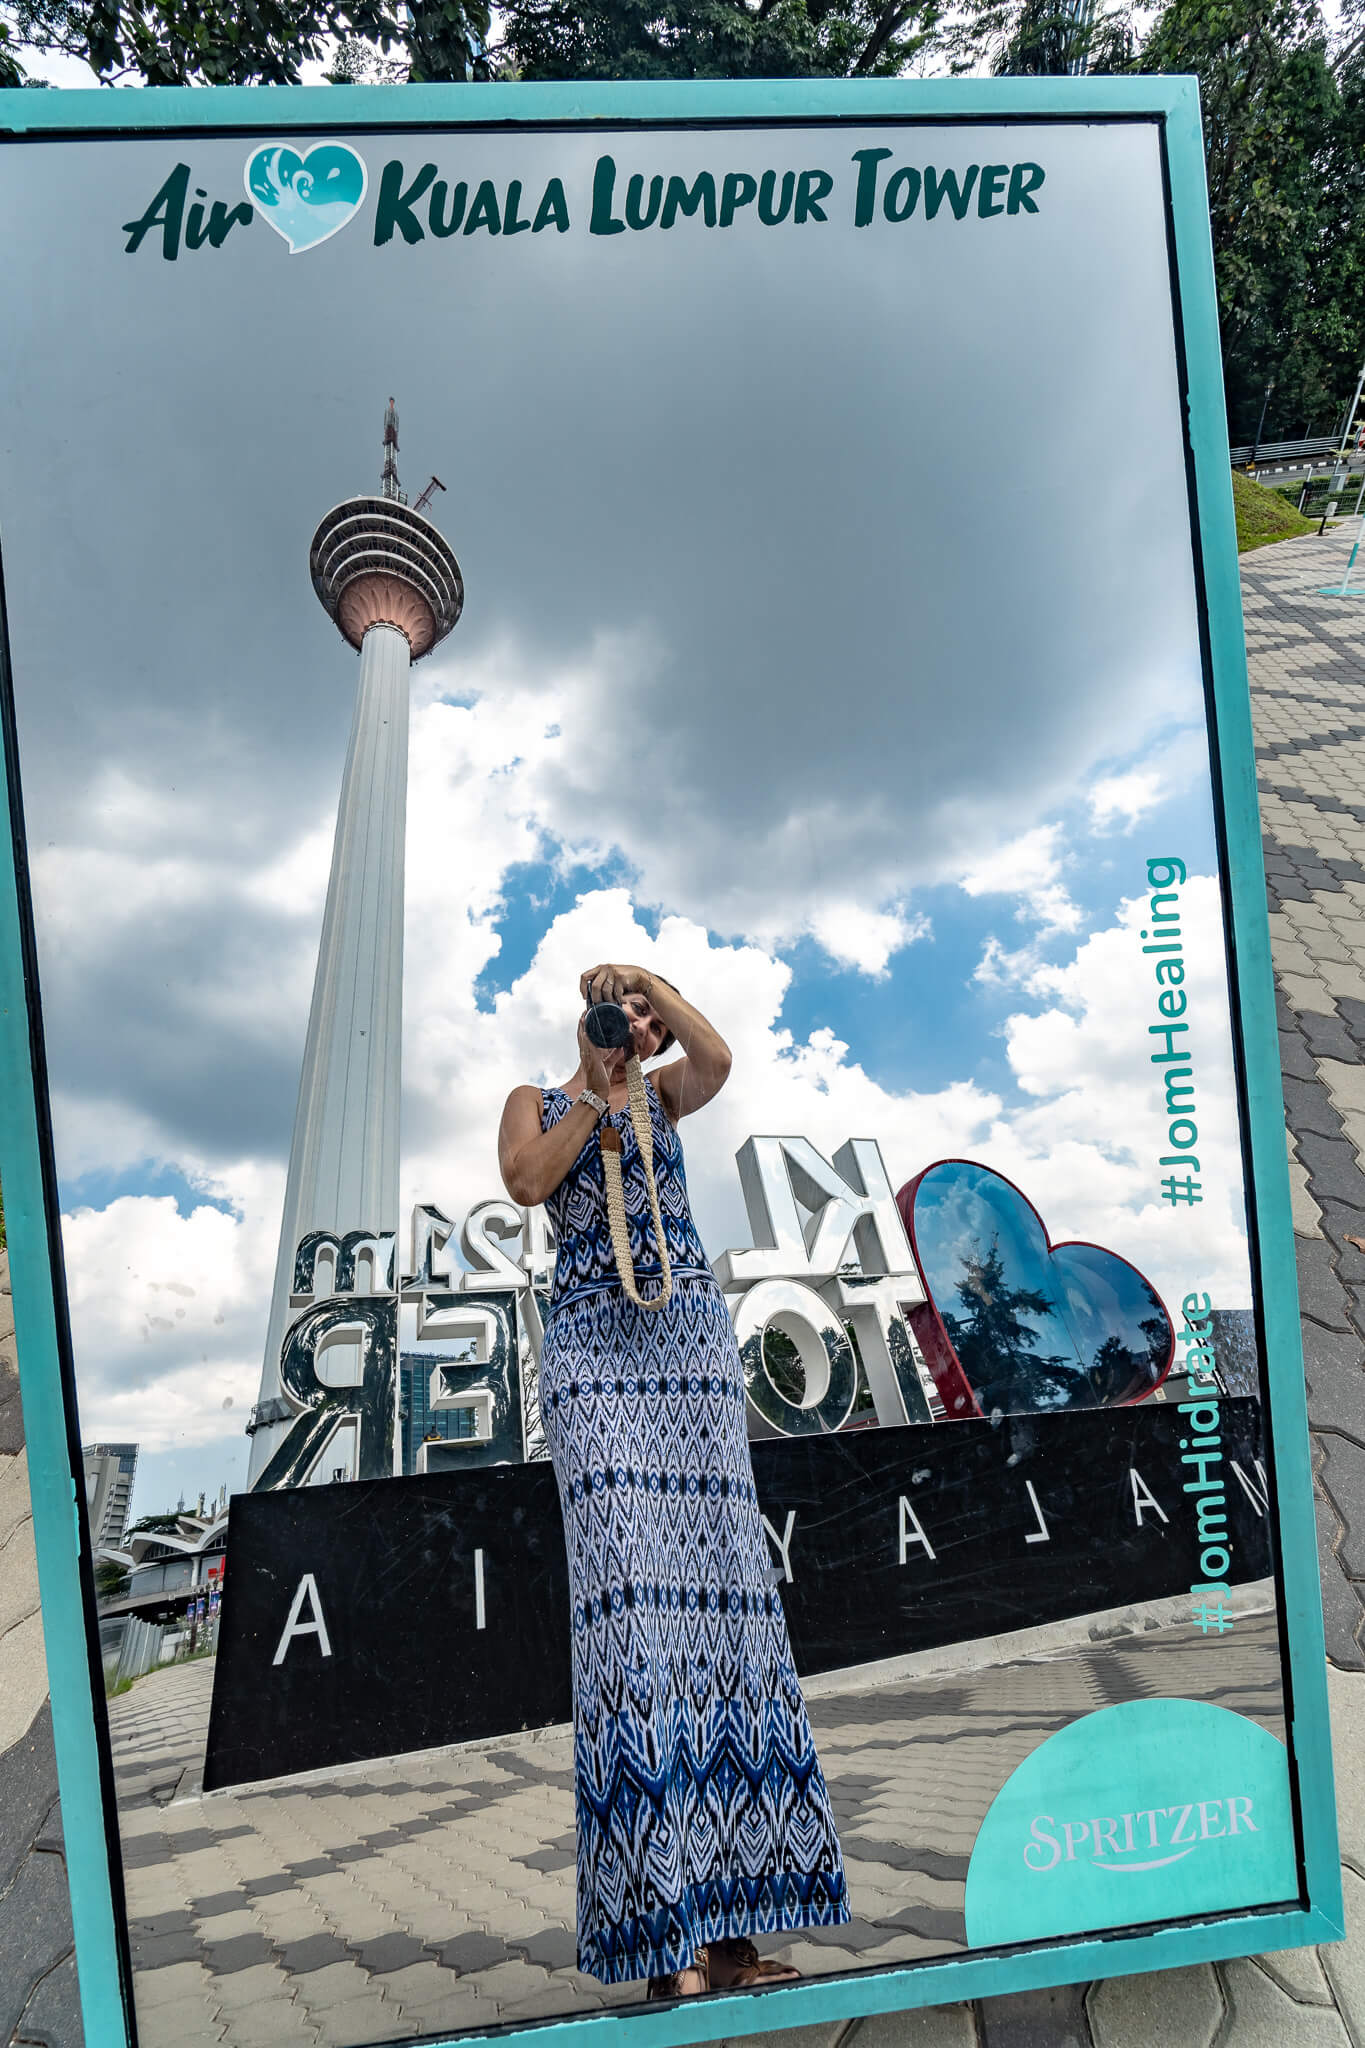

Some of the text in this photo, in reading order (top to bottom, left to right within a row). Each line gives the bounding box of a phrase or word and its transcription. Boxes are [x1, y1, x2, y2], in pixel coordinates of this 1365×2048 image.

[122, 147, 1046, 261] Air KUALA LUMPUR TOWER
[1140, 856, 1203, 1206] #JomHealing
[1176, 1292, 1235, 1634] #JomHidrate
[1023, 1796, 1259, 1872] SPRITZER
